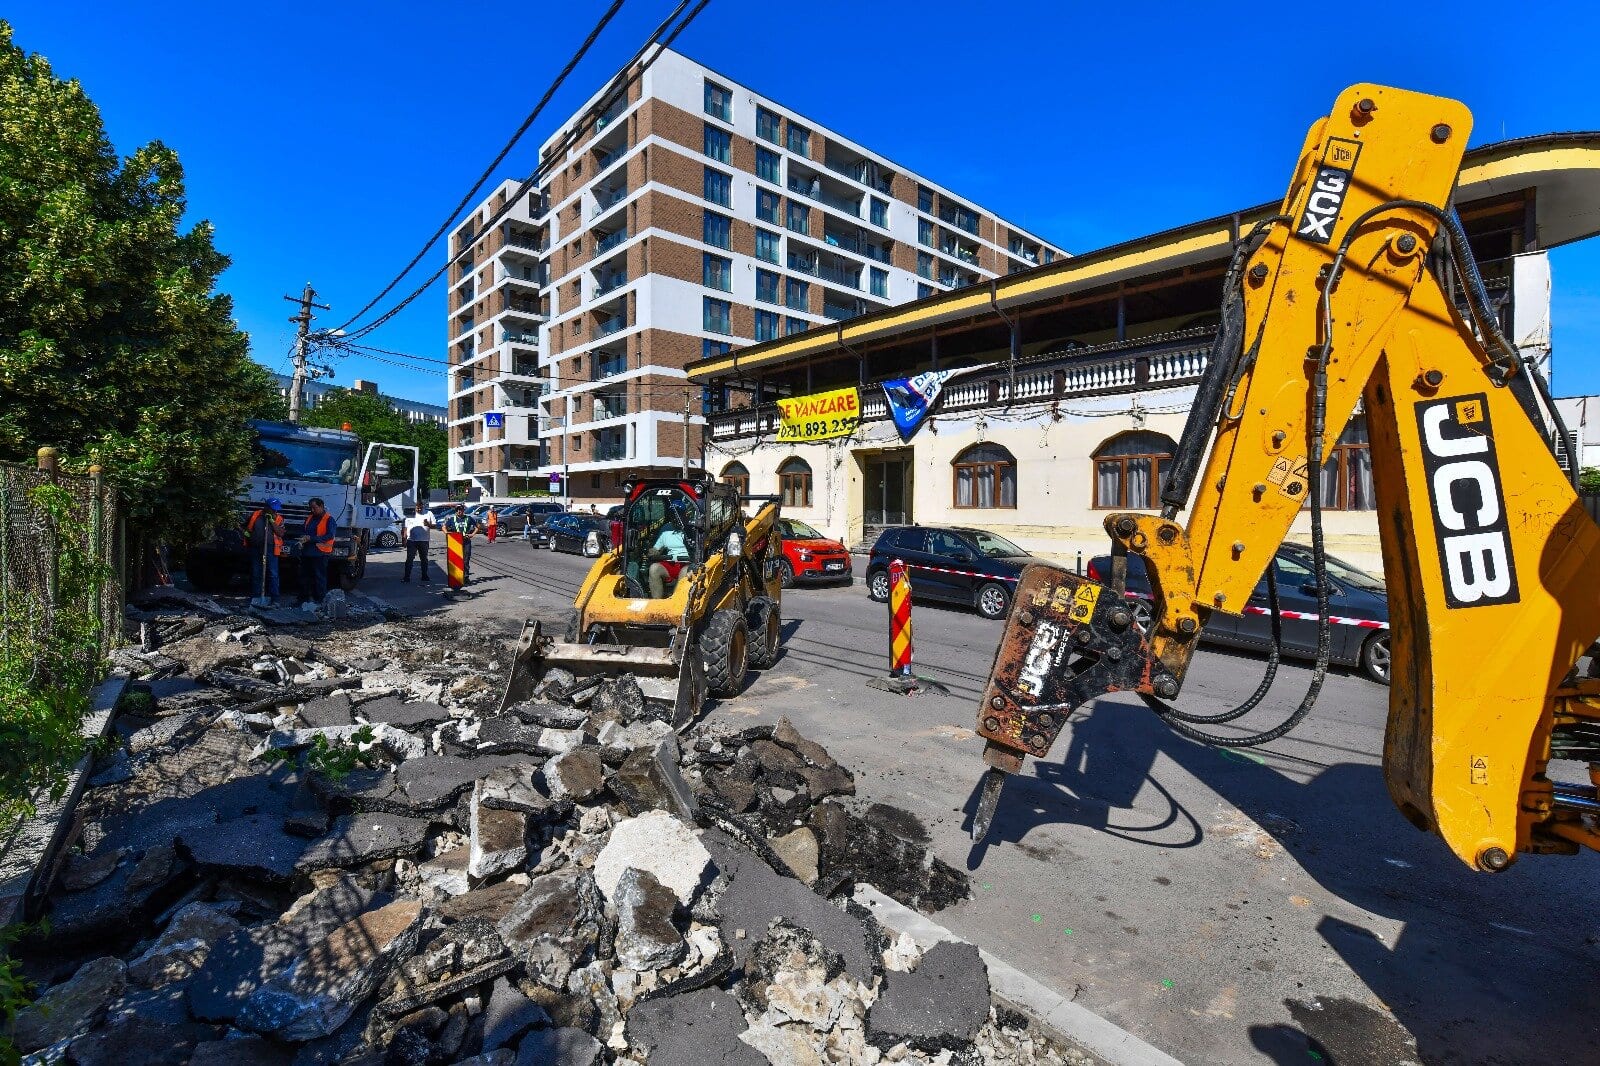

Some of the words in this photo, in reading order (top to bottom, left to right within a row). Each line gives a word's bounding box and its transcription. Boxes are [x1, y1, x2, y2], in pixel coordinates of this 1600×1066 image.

[1333, 148, 1351, 161] JCB
[1298, 168, 1347, 239] 3CX
[794, 394, 857, 418] VANZARE
[1423, 403, 1511, 603] JCB
